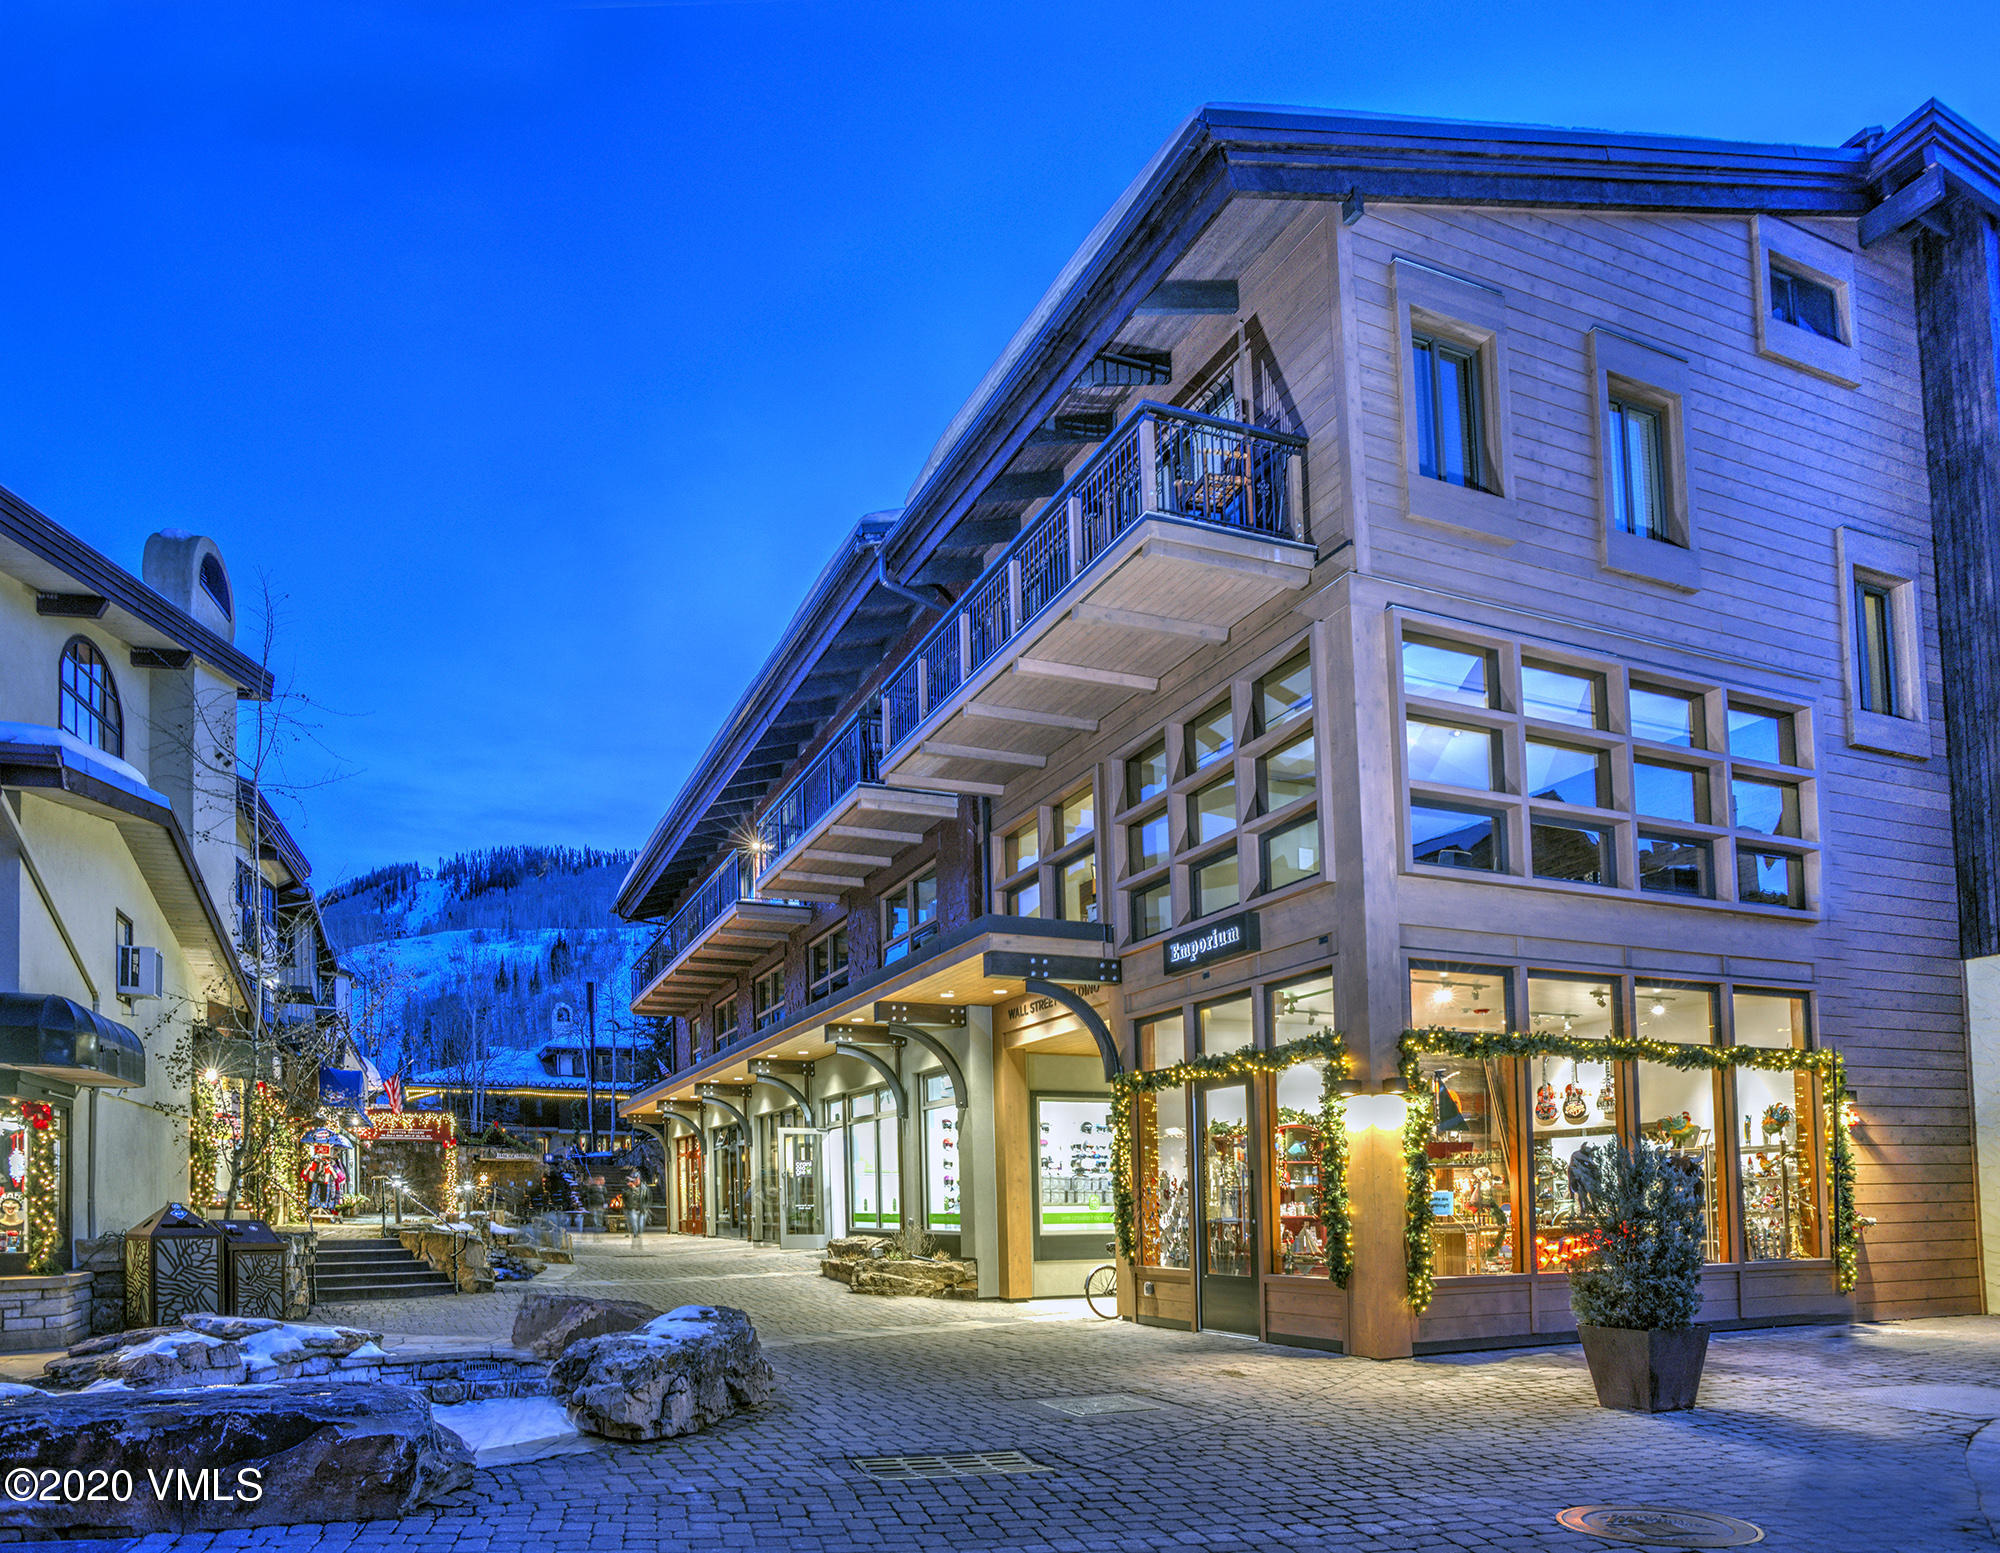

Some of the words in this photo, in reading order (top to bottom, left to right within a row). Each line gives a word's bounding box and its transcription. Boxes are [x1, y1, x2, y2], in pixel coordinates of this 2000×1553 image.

[1170, 926, 1240, 962] Emporium
[1008, 1004, 1028, 1020] WALL
[1030, 996, 1057, 1014] STREET
